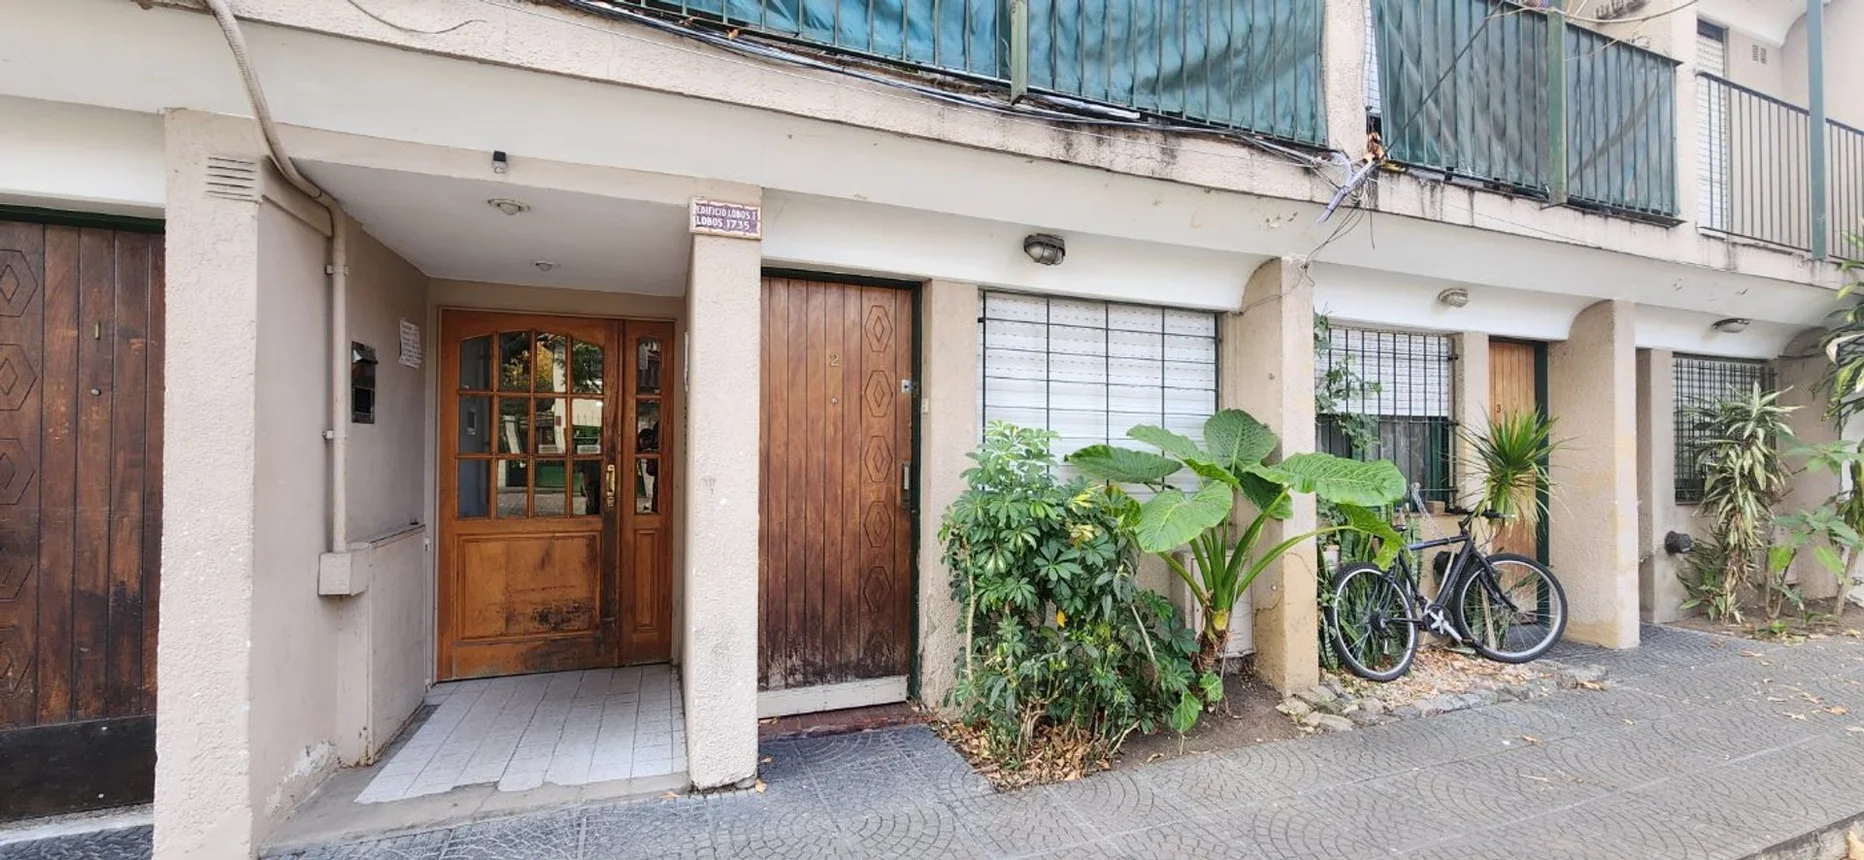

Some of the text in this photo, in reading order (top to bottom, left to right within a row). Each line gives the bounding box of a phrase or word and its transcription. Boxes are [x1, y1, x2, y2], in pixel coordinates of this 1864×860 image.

[697, 205, 726, 217] EDIFICIO
[727, 209, 750, 220] LOBOS
[696, 216, 750, 231] LOBOS 1735
[829, 353, 840, 367] 2
[1496, 404, 1501, 413] 3
